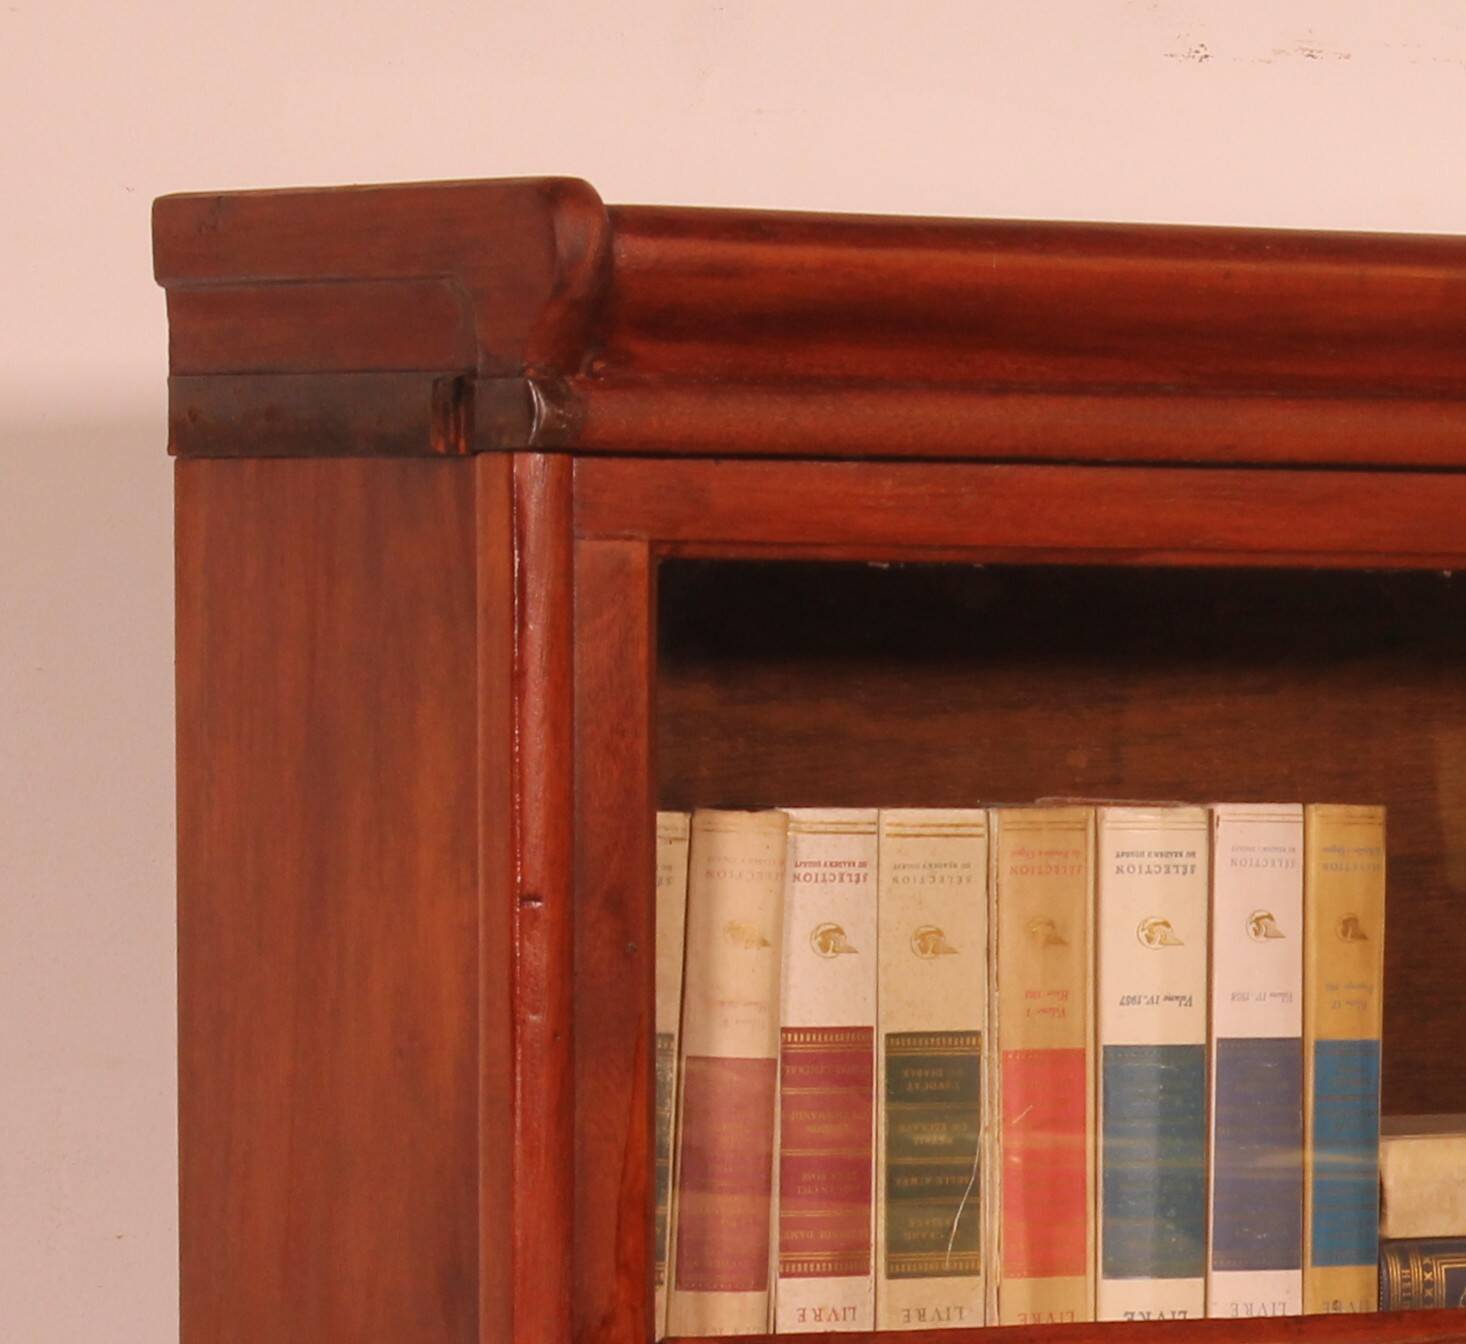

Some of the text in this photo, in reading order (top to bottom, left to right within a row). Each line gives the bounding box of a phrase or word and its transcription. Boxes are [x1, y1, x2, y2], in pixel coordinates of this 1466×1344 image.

[1115, 864, 1196, 876] SÉLECTION
[792, 872, 868, 885] SÉLECTION
[891, 875, 972, 886] SÉLECTION
[1163, 995, 1193, 1007] Volume
[796, 1306, 857, 1323] LIVRE
[901, 1306, 964, 1324] LIVRE
[1230, 1301, 1287, 1317] LIVRE
